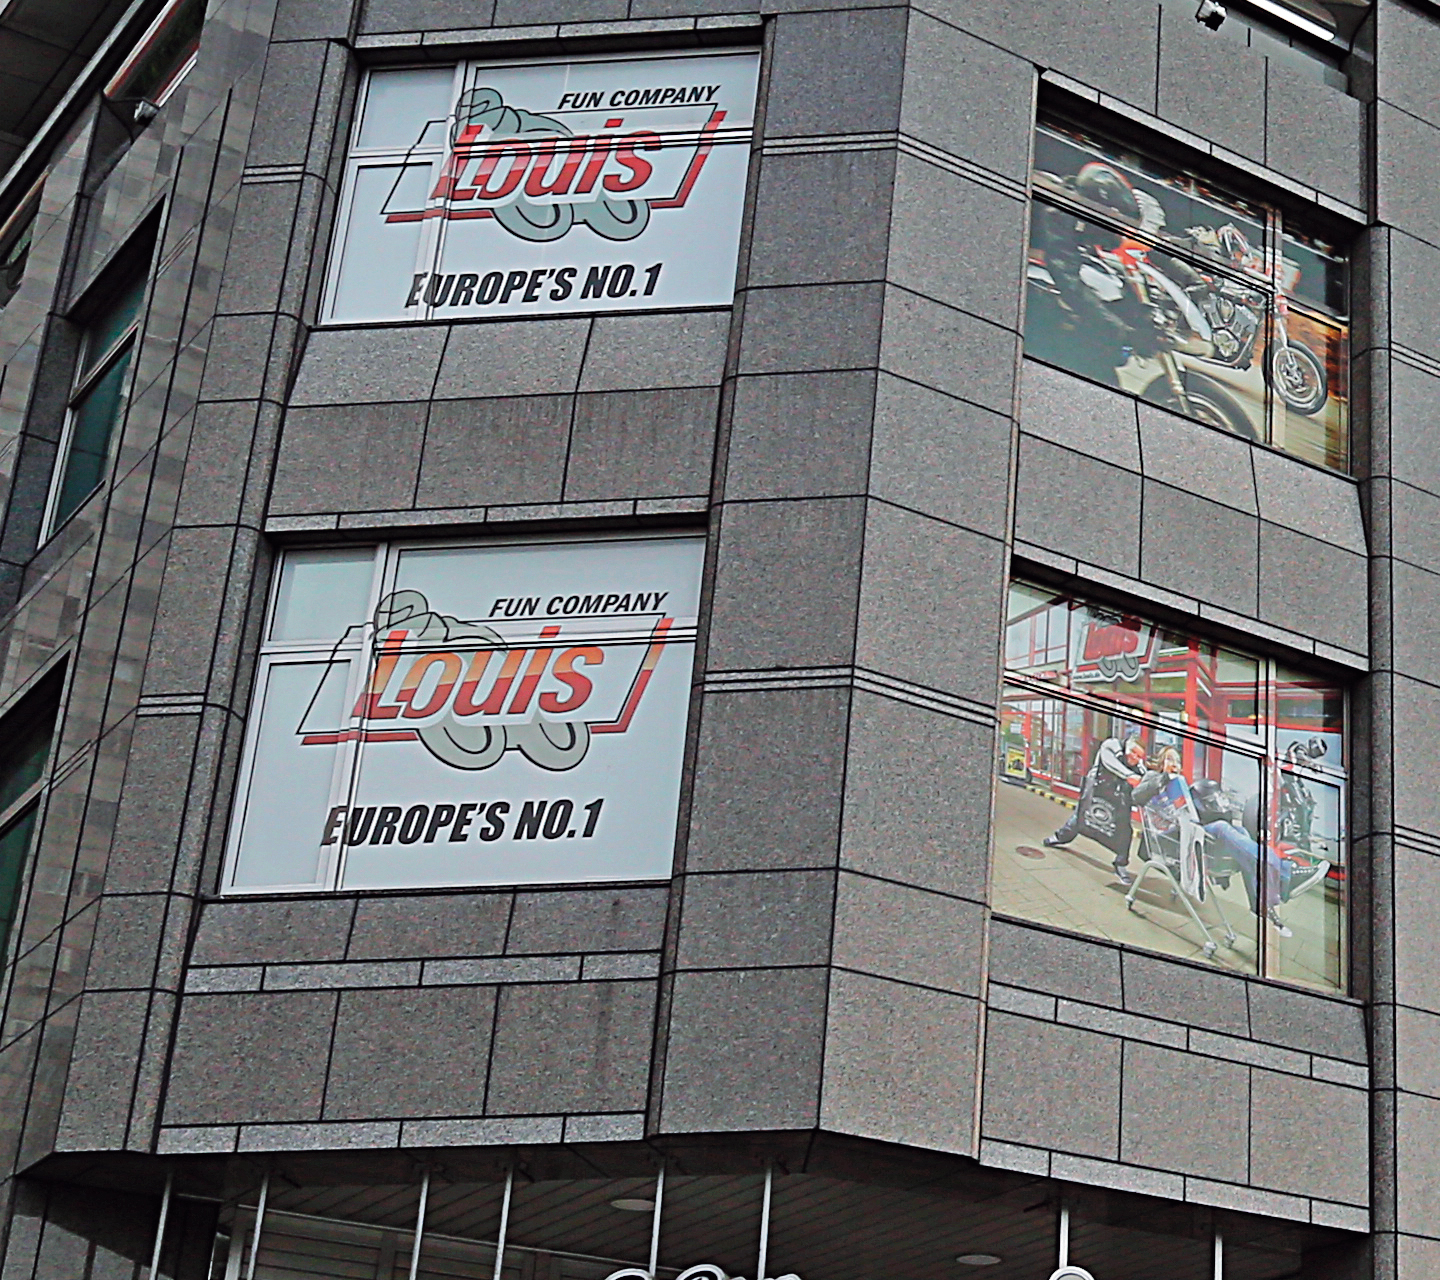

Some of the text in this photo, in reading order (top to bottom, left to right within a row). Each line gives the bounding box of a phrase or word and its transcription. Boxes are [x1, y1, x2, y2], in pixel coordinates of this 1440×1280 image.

[558, 85, 721, 110] FUN COMPANY
[430, 118, 663, 200] Louis
[406, 262, 663, 308] EUROPE'S NO.1
[490, 592, 669, 617] FUN COMPANY
[351, 626, 604, 719] Louis
[321, 798, 604, 847] EUROPE'S NO.1
